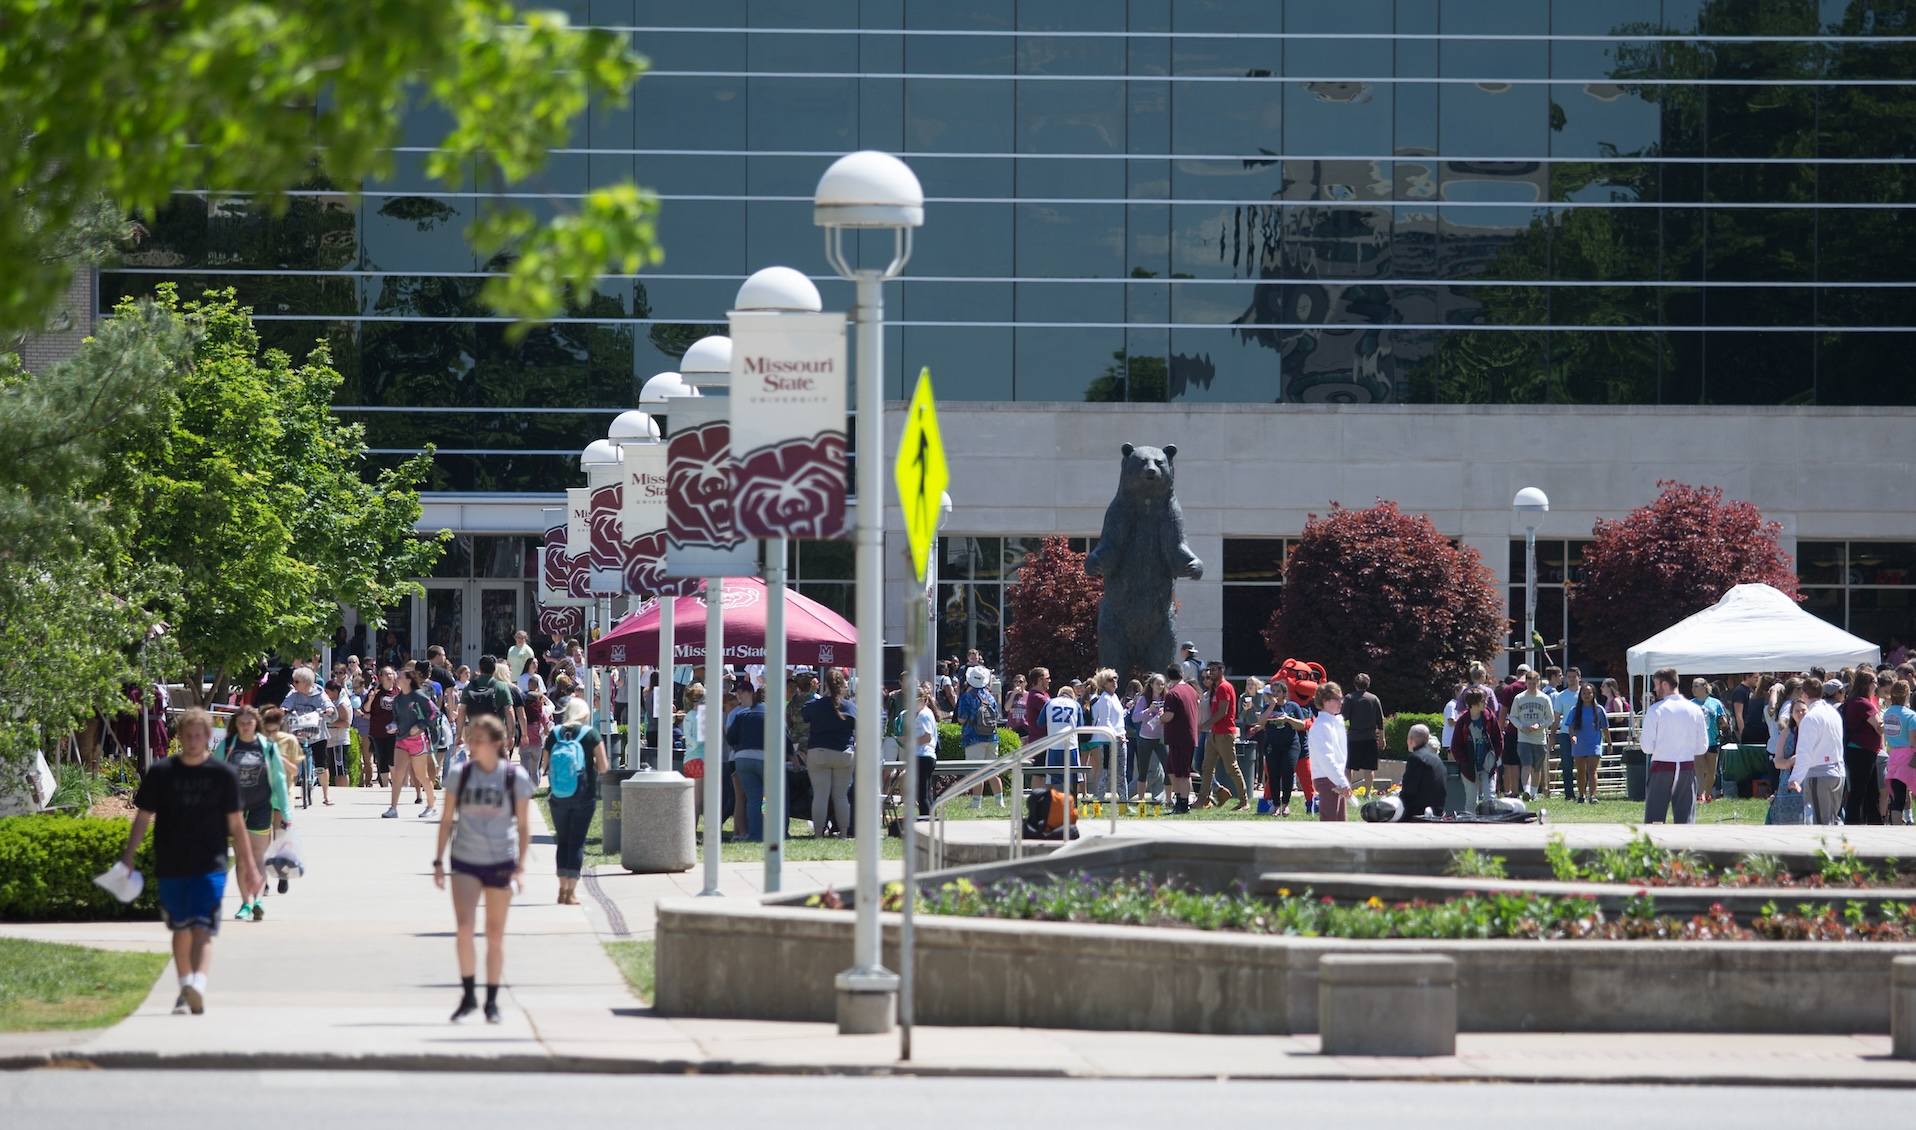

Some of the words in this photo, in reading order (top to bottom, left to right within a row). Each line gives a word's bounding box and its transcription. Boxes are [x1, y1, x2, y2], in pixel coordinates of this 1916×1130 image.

[743, 357, 833, 374] Missouri
[763, 374, 814, 392] State
[631, 473, 667, 485] Miss
[645, 485, 667, 497] Sta
[1518, 702, 1544, 712] MISSOURI
[1052, 706, 1074, 723] 27
